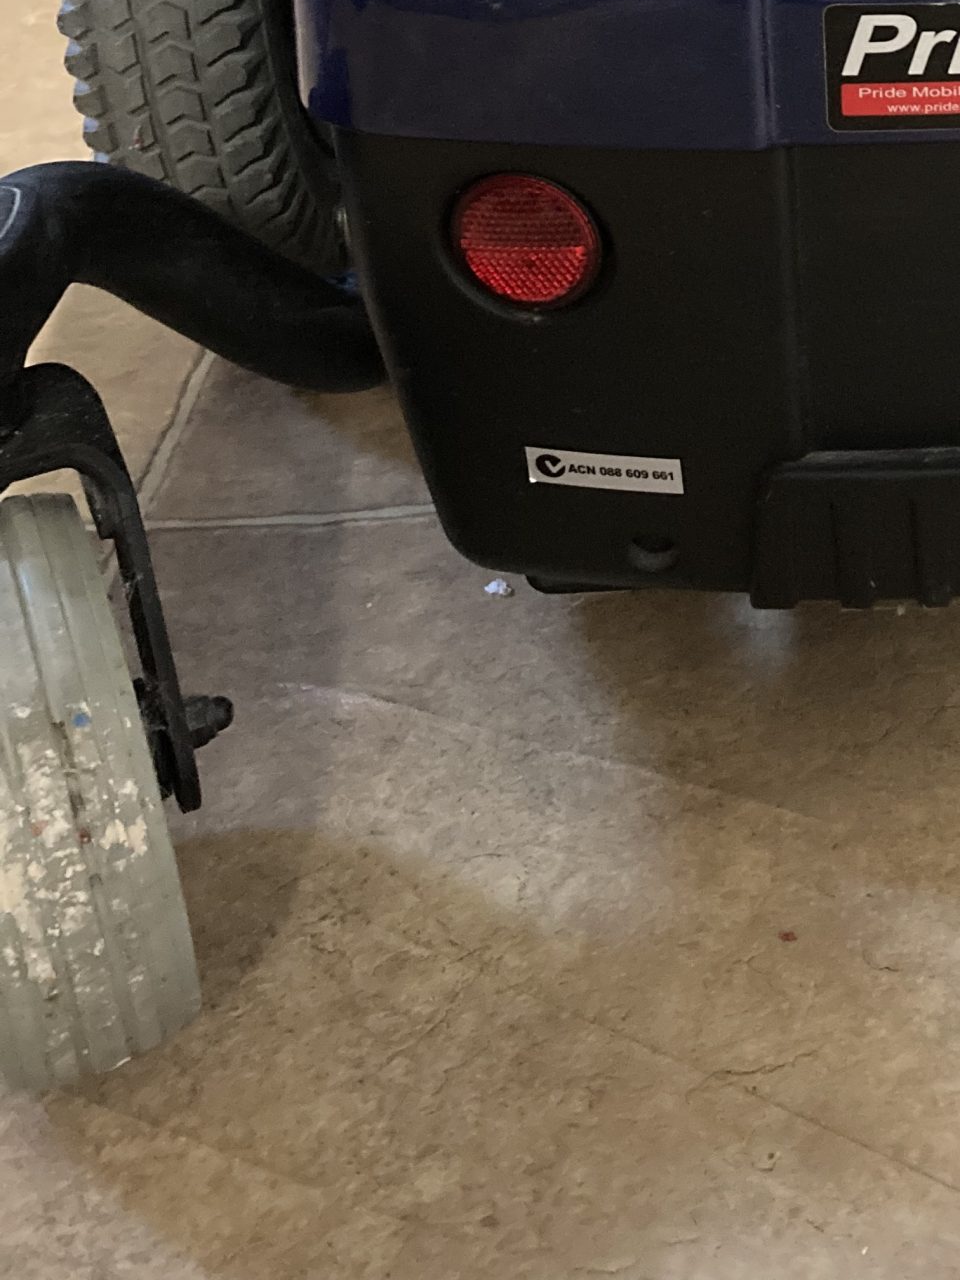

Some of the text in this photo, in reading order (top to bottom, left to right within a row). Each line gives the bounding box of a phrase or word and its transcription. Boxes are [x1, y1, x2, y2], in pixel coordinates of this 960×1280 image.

[858, 86, 907, 99] Pride
[568, 464, 674, 481] ACN 088 609 661
